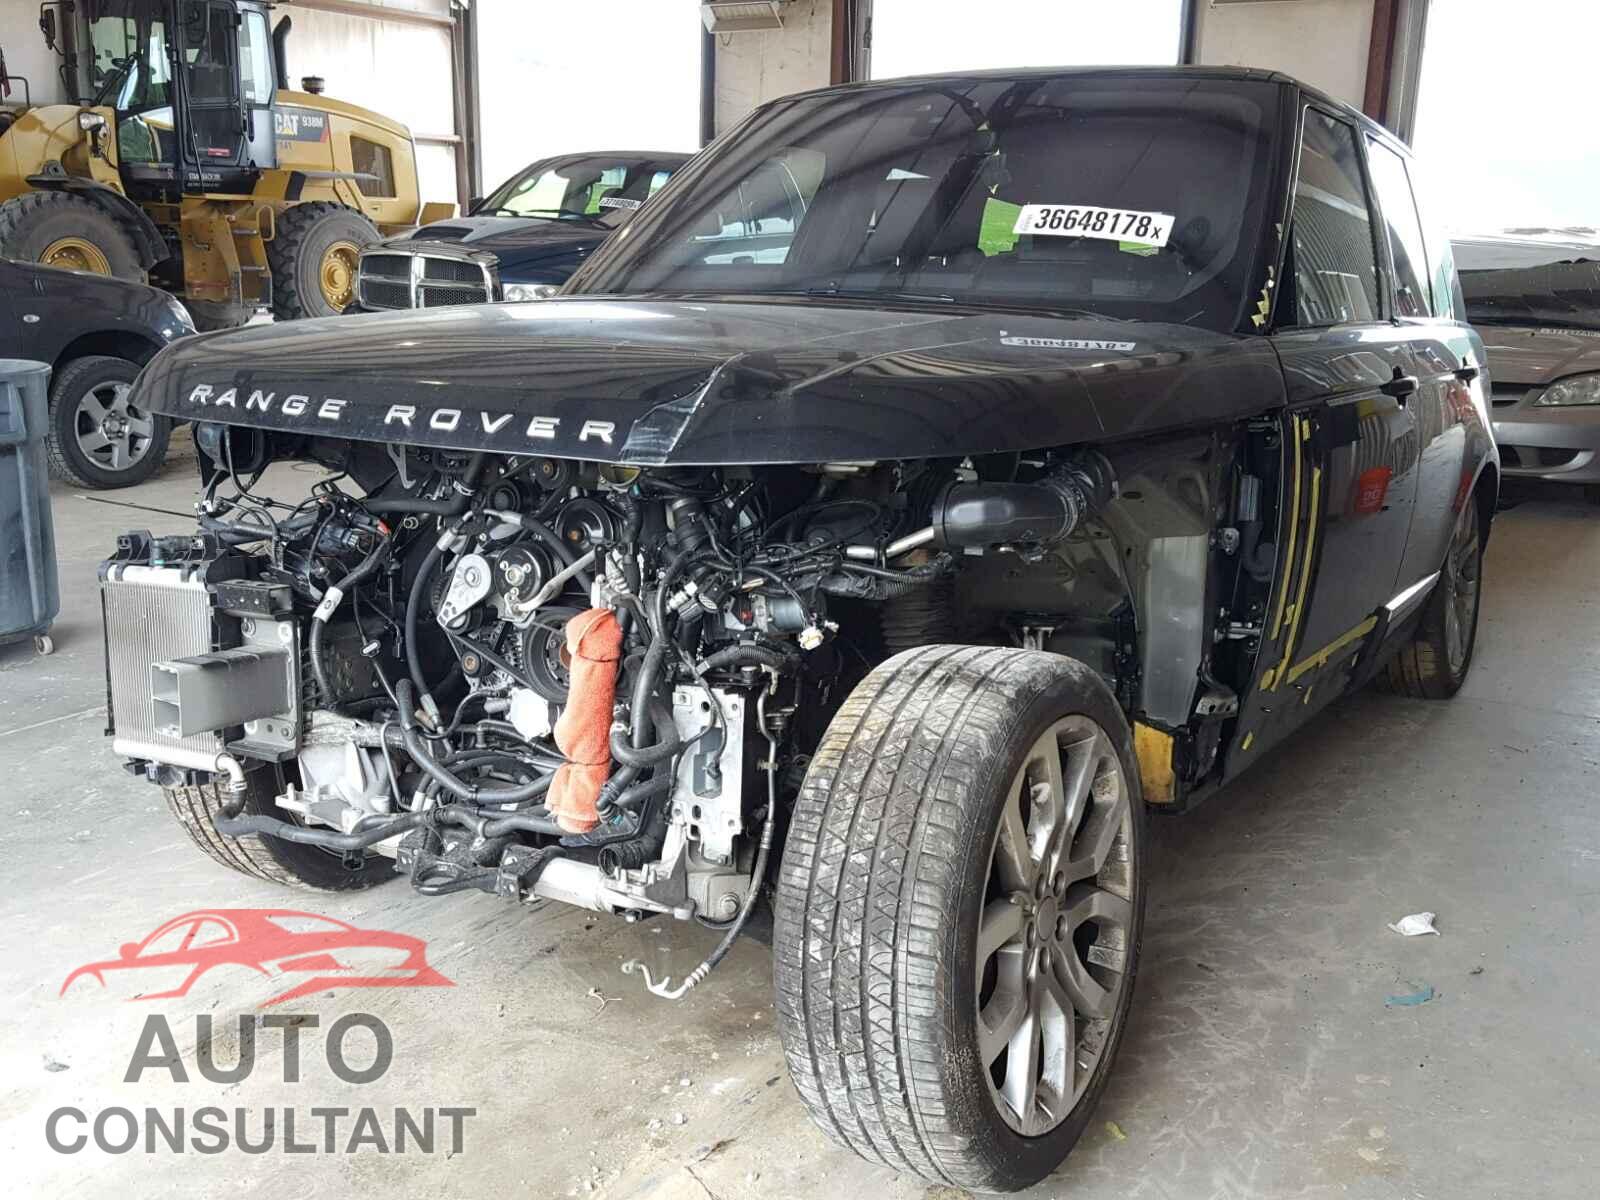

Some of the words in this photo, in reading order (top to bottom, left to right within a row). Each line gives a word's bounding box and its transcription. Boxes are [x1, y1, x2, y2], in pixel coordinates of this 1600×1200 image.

[275, 113, 299, 136] CAT
[302, 115, 324, 128] 938M
[188, 384, 348, 421] RANGE
[384, 404, 617, 444] ROVER
